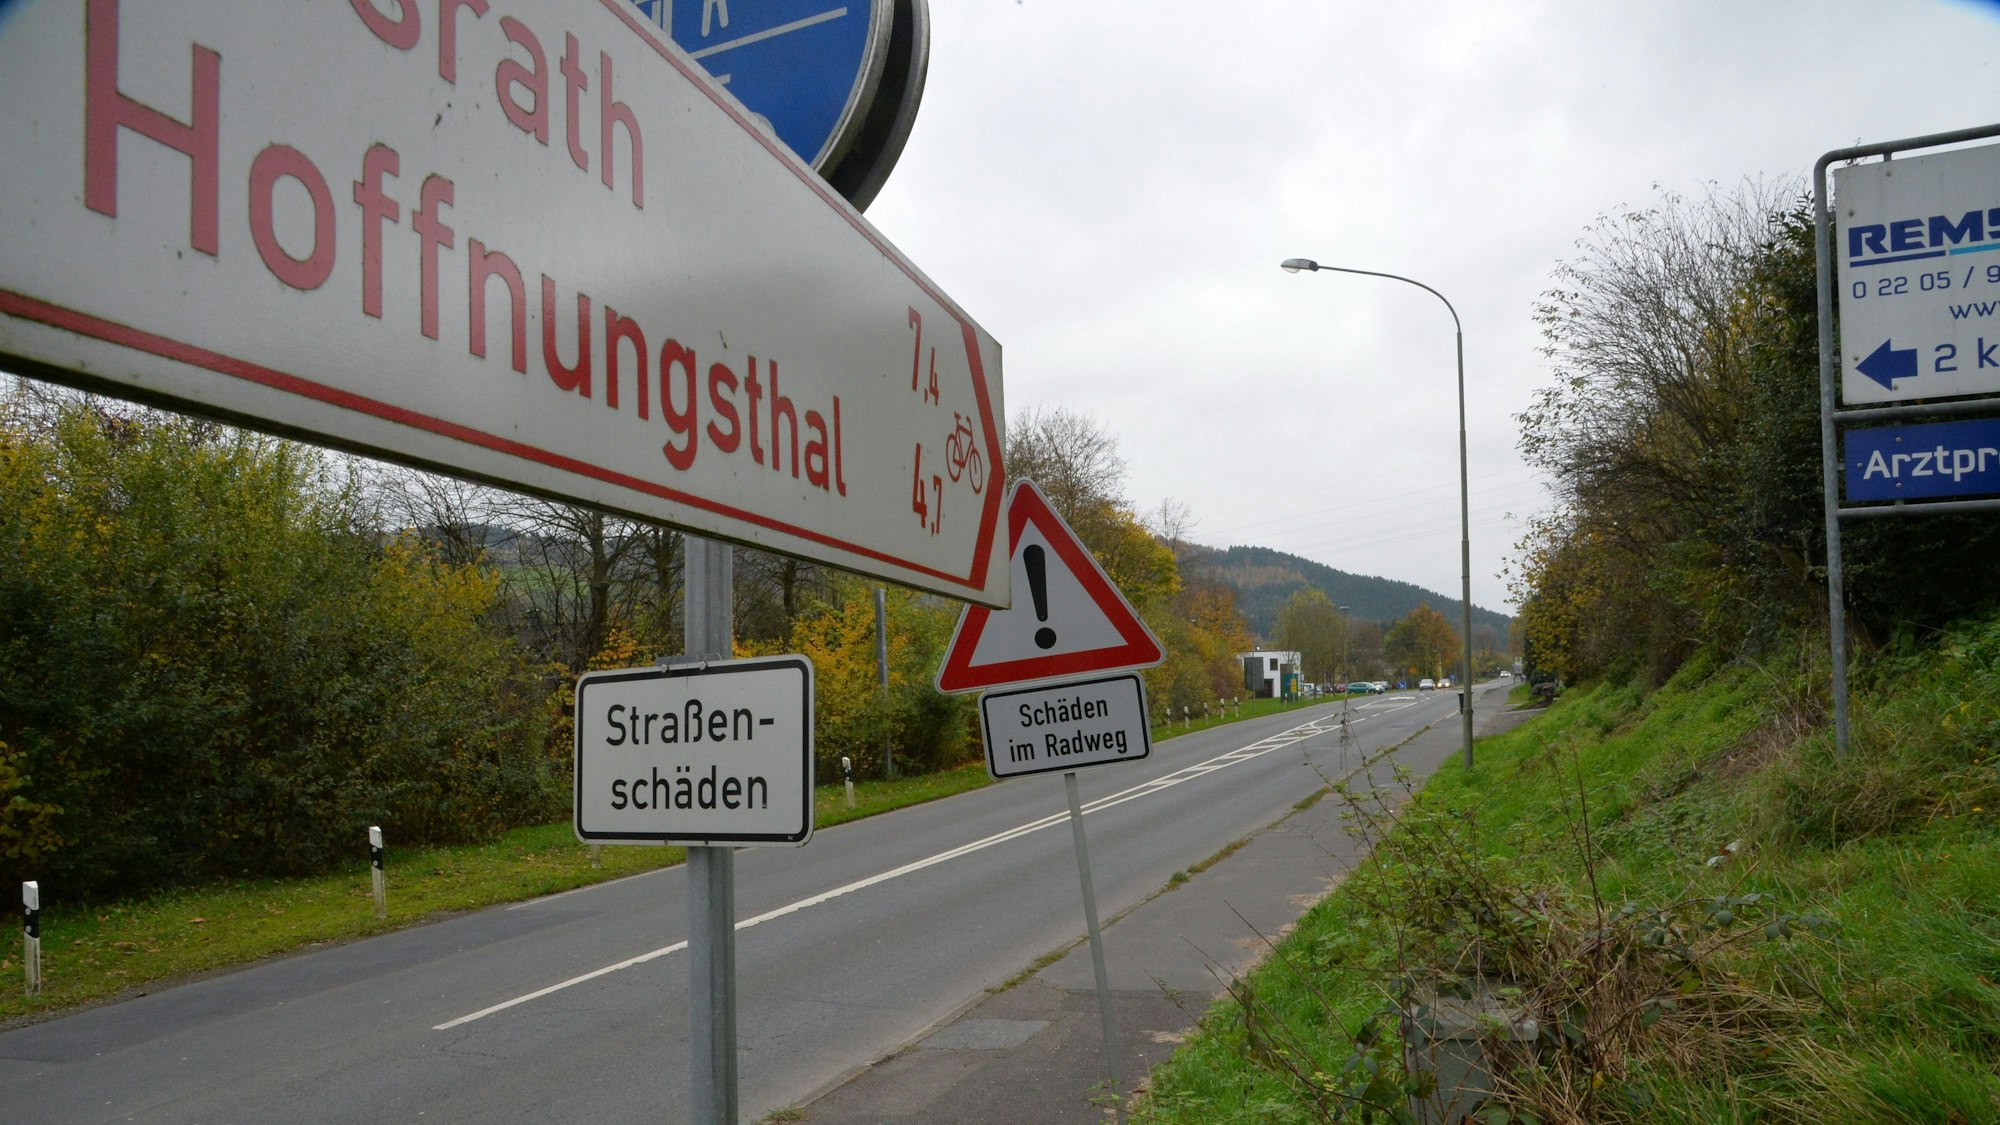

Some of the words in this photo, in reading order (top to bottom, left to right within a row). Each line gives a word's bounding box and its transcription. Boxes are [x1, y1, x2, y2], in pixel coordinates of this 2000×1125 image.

[84, 0, 847, 498] Hoffnungsthal
[1852, 281, 1867, 299] 0
[1878, 276, 1909, 296] 22
[1920, 271, 1951, 291] 05
[1962, 265, 1975, 288] /
[1948, 300, 2000, 320] ww
[908, 305, 940, 407] 7,4
[1934, 343, 1958, 373] 2
[1863, 445, 2000, 482] Arztpr
[912, 442, 943, 527] 4,7
[605, 699, 775, 747] Straßen-
[1019, 696, 1109, 728] Schäden
[1009, 738, 1035, 763] im
[1044, 729, 1128, 758] Radweg
[610, 764, 768, 810] schäden
